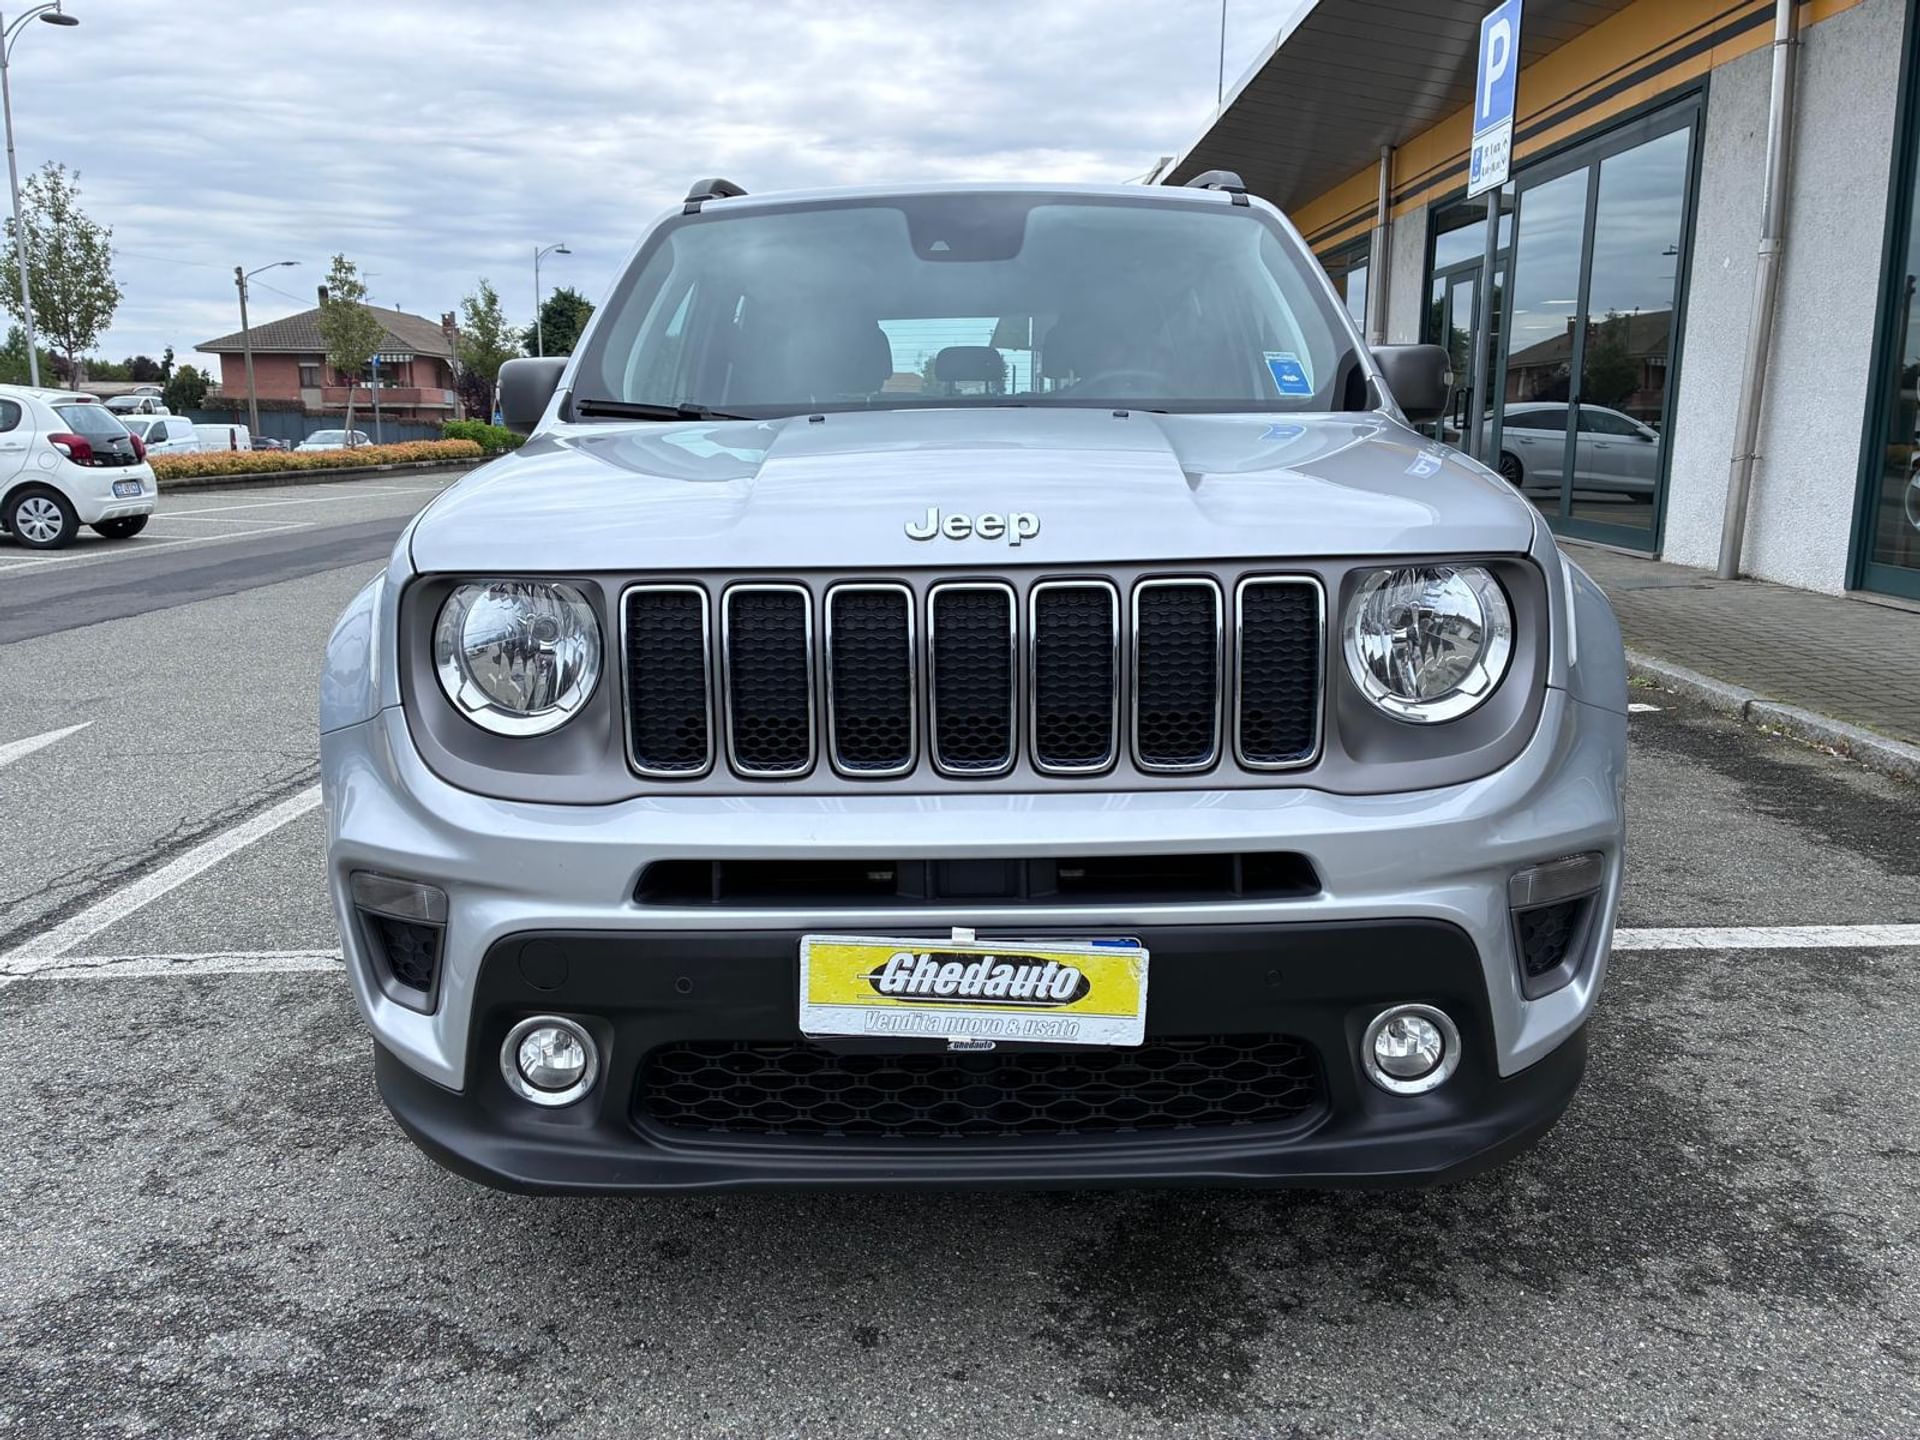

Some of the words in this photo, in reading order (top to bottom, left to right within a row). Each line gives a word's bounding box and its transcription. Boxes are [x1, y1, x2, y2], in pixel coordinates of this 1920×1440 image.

[1482, 18, 1511, 119] P
[904, 506, 1041, 547] Jeep
[878, 951, 1082, 1000] Ghedauto
[864, 1010, 941, 1033] Vendita
[943, 1016, 1004, 1035] nuovo
[1006, 1019, 1020, 1036] &
[1022, 1019, 1080, 1038] usato
